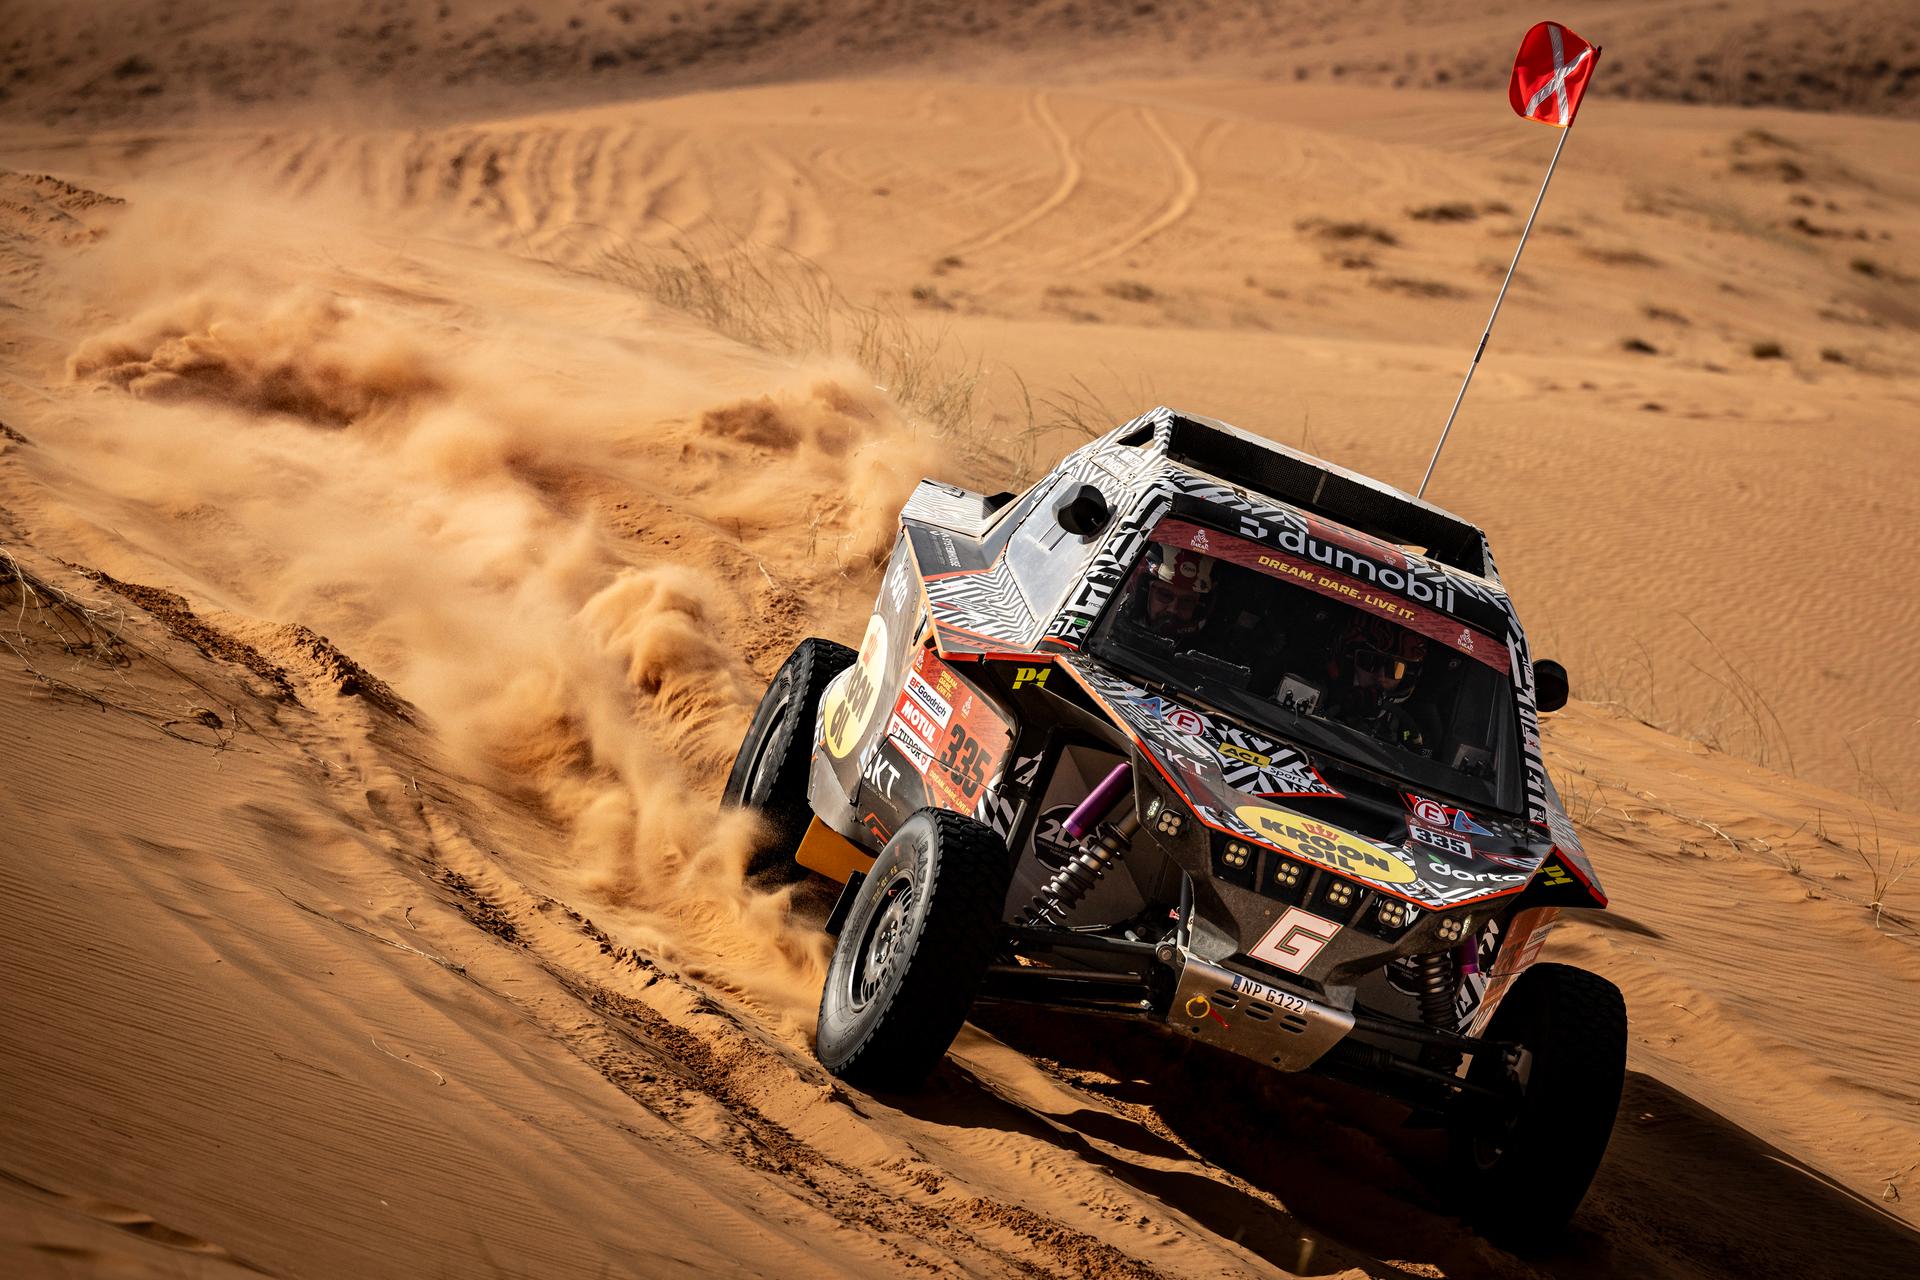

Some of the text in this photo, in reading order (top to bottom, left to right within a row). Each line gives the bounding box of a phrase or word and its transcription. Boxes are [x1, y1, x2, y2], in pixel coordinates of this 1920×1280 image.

[1258, 555, 1416, 622] DREAM. DARE. LIVE IT.
[1278, 530, 1455, 614] dumobil
[909, 676, 947, 718] BFGoodrich
[1012, 667, 1052, 690] P1
[830, 699, 850, 750] OIL
[900, 700, 937, 743] MOTUL
[1177, 714, 1196, 728] E
[899, 728, 922, 760] TUDOR
[940, 723, 993, 799] 335
[1147, 738, 1208, 776] SKT
[1224, 747, 1264, 766] ACL
[862, 742, 901, 800] SKT
[1260, 816, 1390, 872] KROON
[1298, 842, 1356, 872] OIL
[1415, 827, 1467, 855] 335
[1246, 905, 1345, 975] G
[1241, 979, 1305, 1013] NP G122
